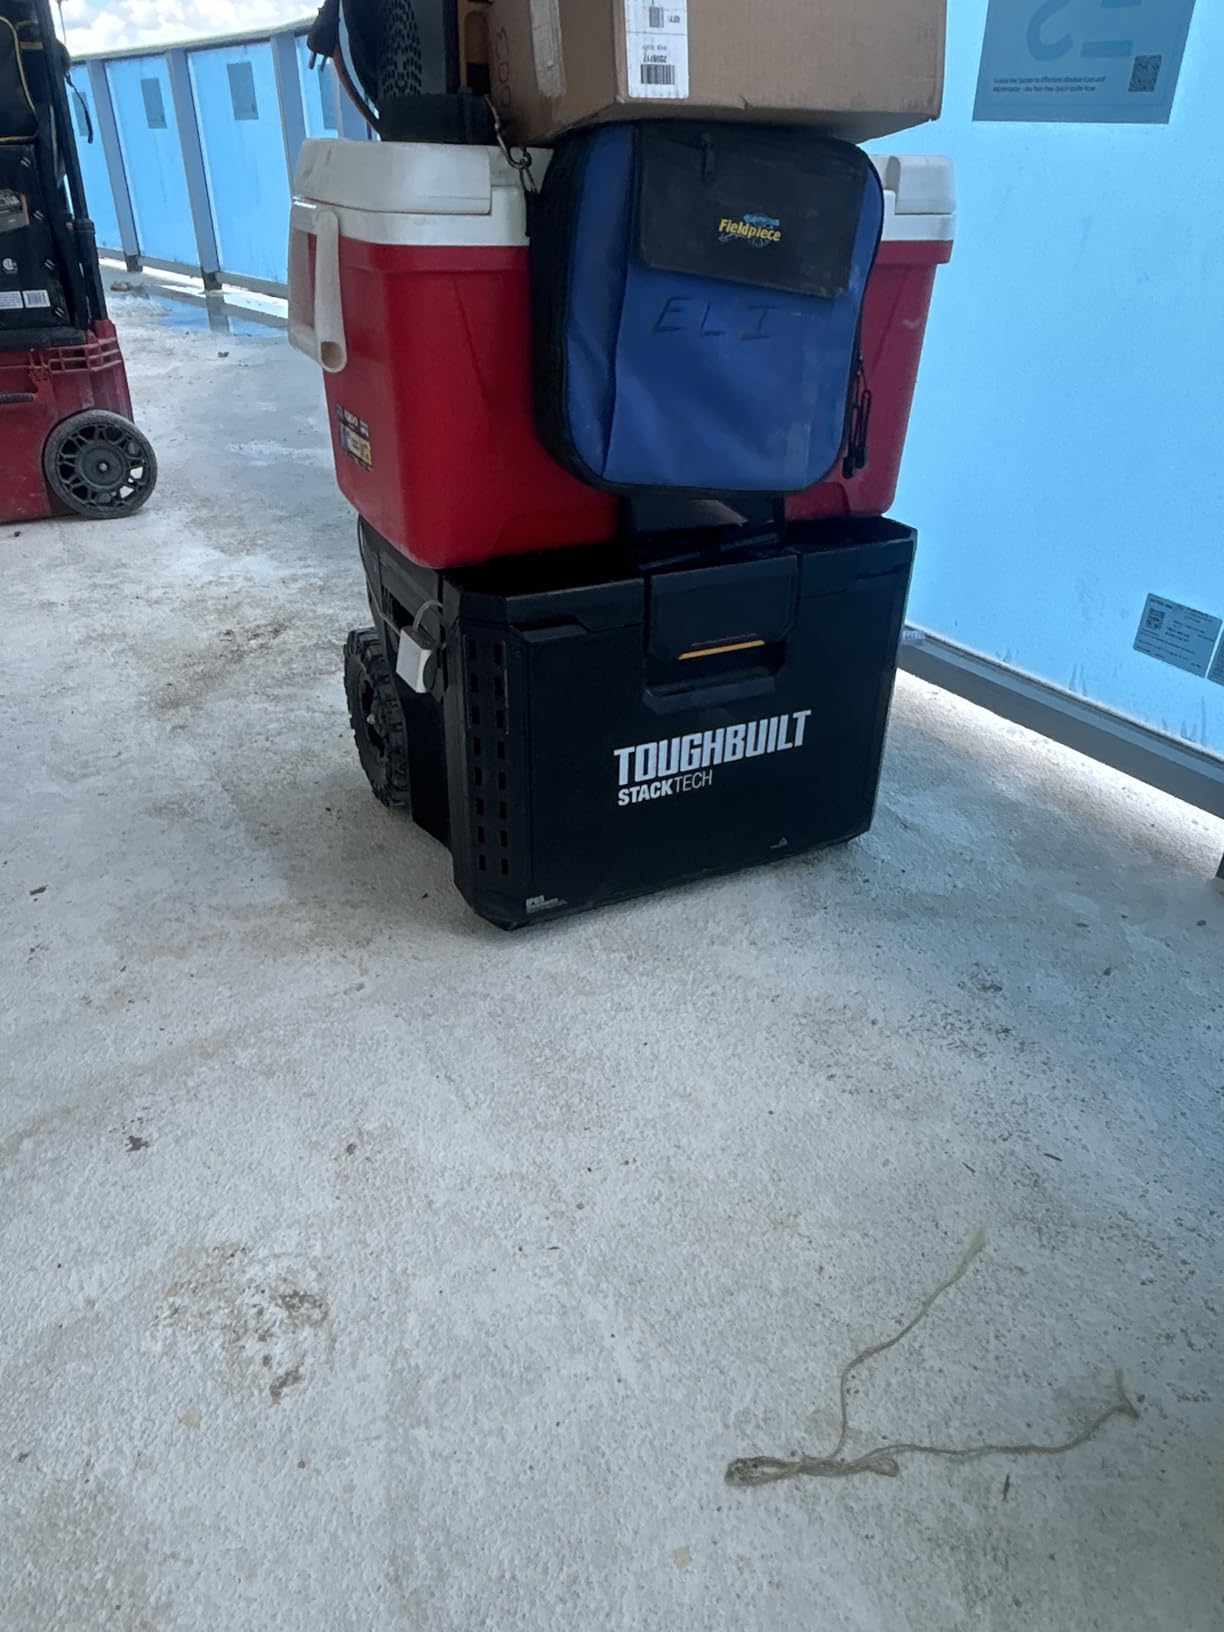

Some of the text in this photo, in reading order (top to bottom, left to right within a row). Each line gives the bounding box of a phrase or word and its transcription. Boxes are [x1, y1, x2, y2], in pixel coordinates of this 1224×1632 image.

[718, 218, 782, 242] Fieldpiece
[613, 709, 812, 786] TOUGHBUILT
[617, 769, 713, 806] STACKTECH
